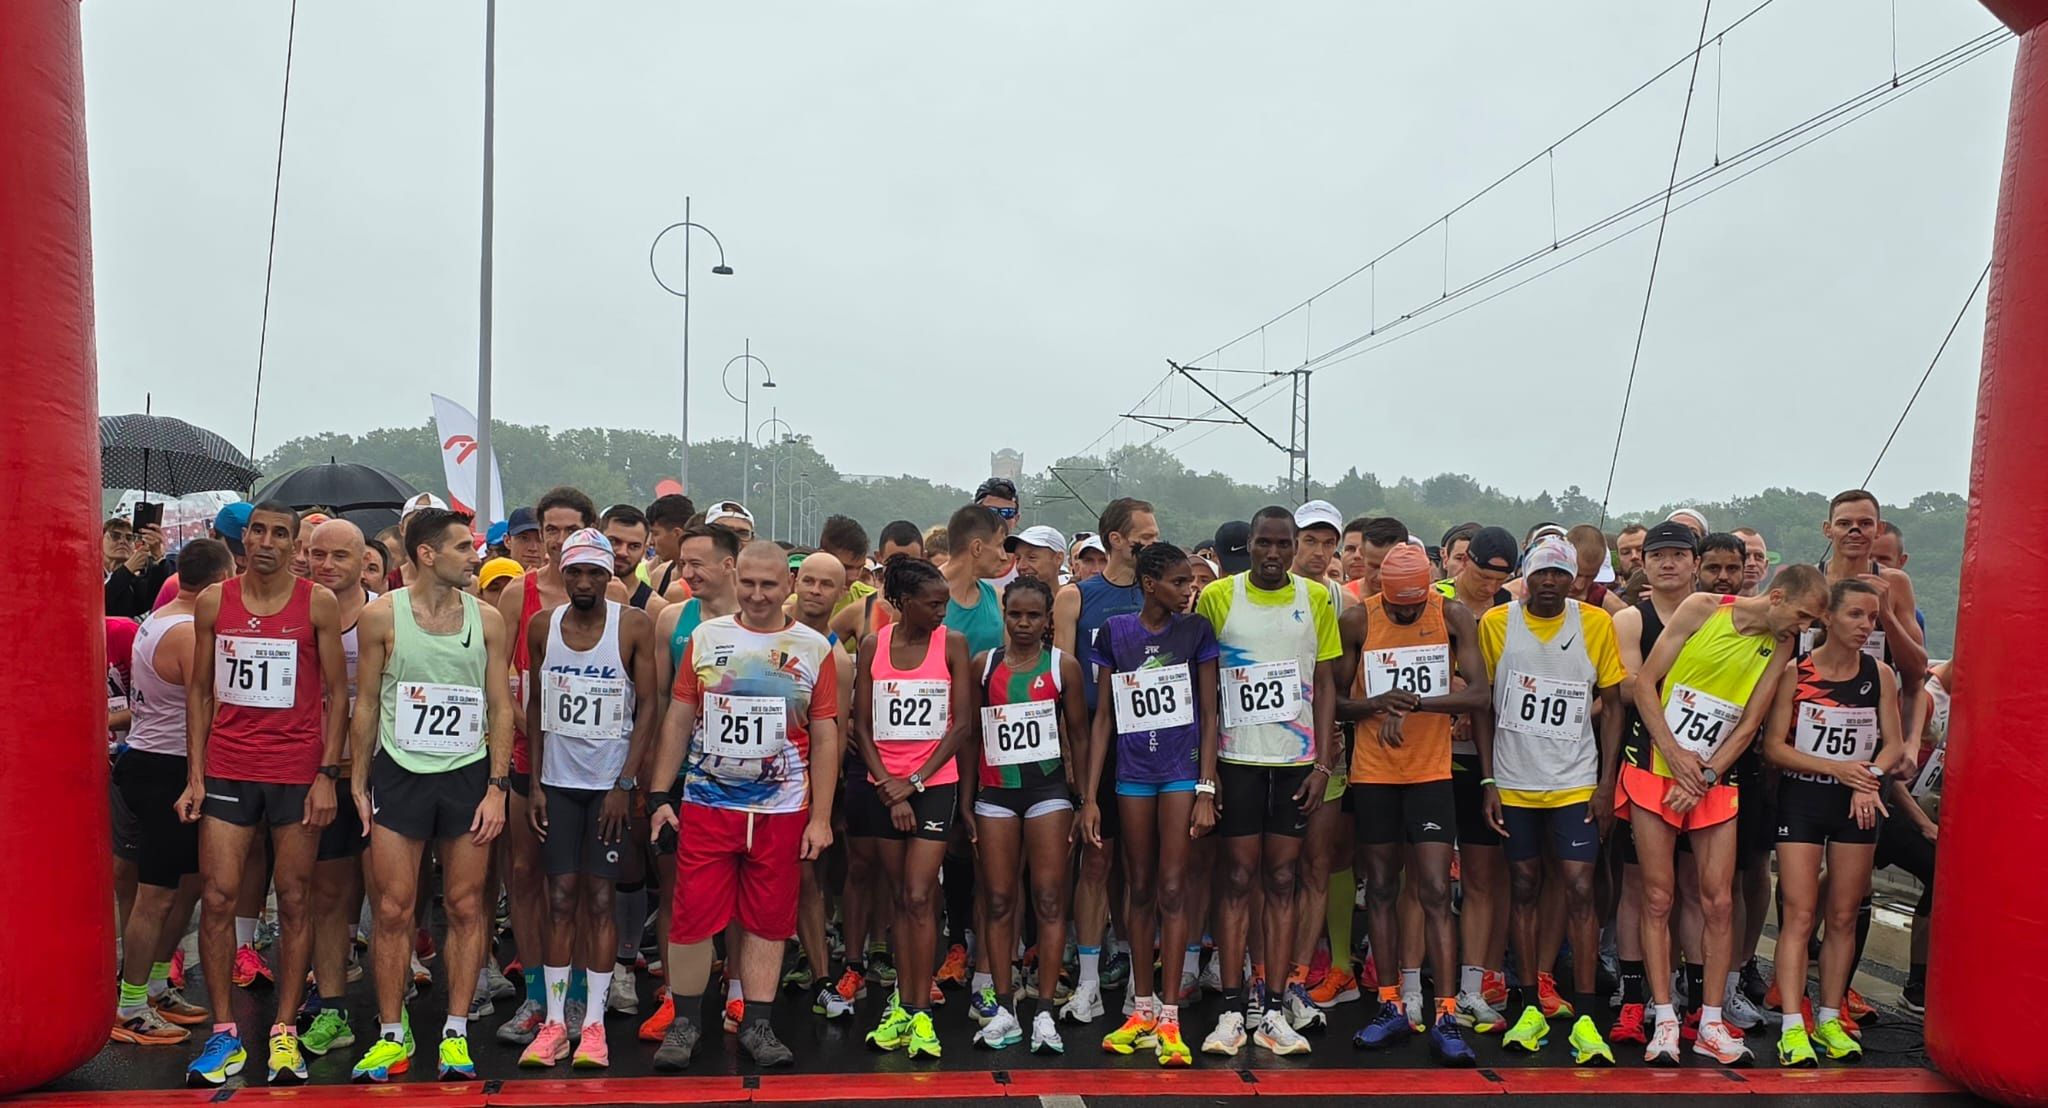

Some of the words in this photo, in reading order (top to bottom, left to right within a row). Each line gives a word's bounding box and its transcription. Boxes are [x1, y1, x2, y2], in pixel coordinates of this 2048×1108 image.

[226, 658, 268, 691] 751
[1386, 665, 1431, 693] 736
[559, 694, 602, 726] 621
[889, 698, 932, 726] 622
[1132, 685, 1176, 718] 603
[1240, 680, 1284, 712] 623
[1520, 693, 1567, 726] 619
[413, 704, 461, 736] 722
[720, 715, 763, 745] 251
[998, 721, 1040, 751] 620
[1674, 707, 1723, 747] 754
[1812, 724, 1857, 755] 755
